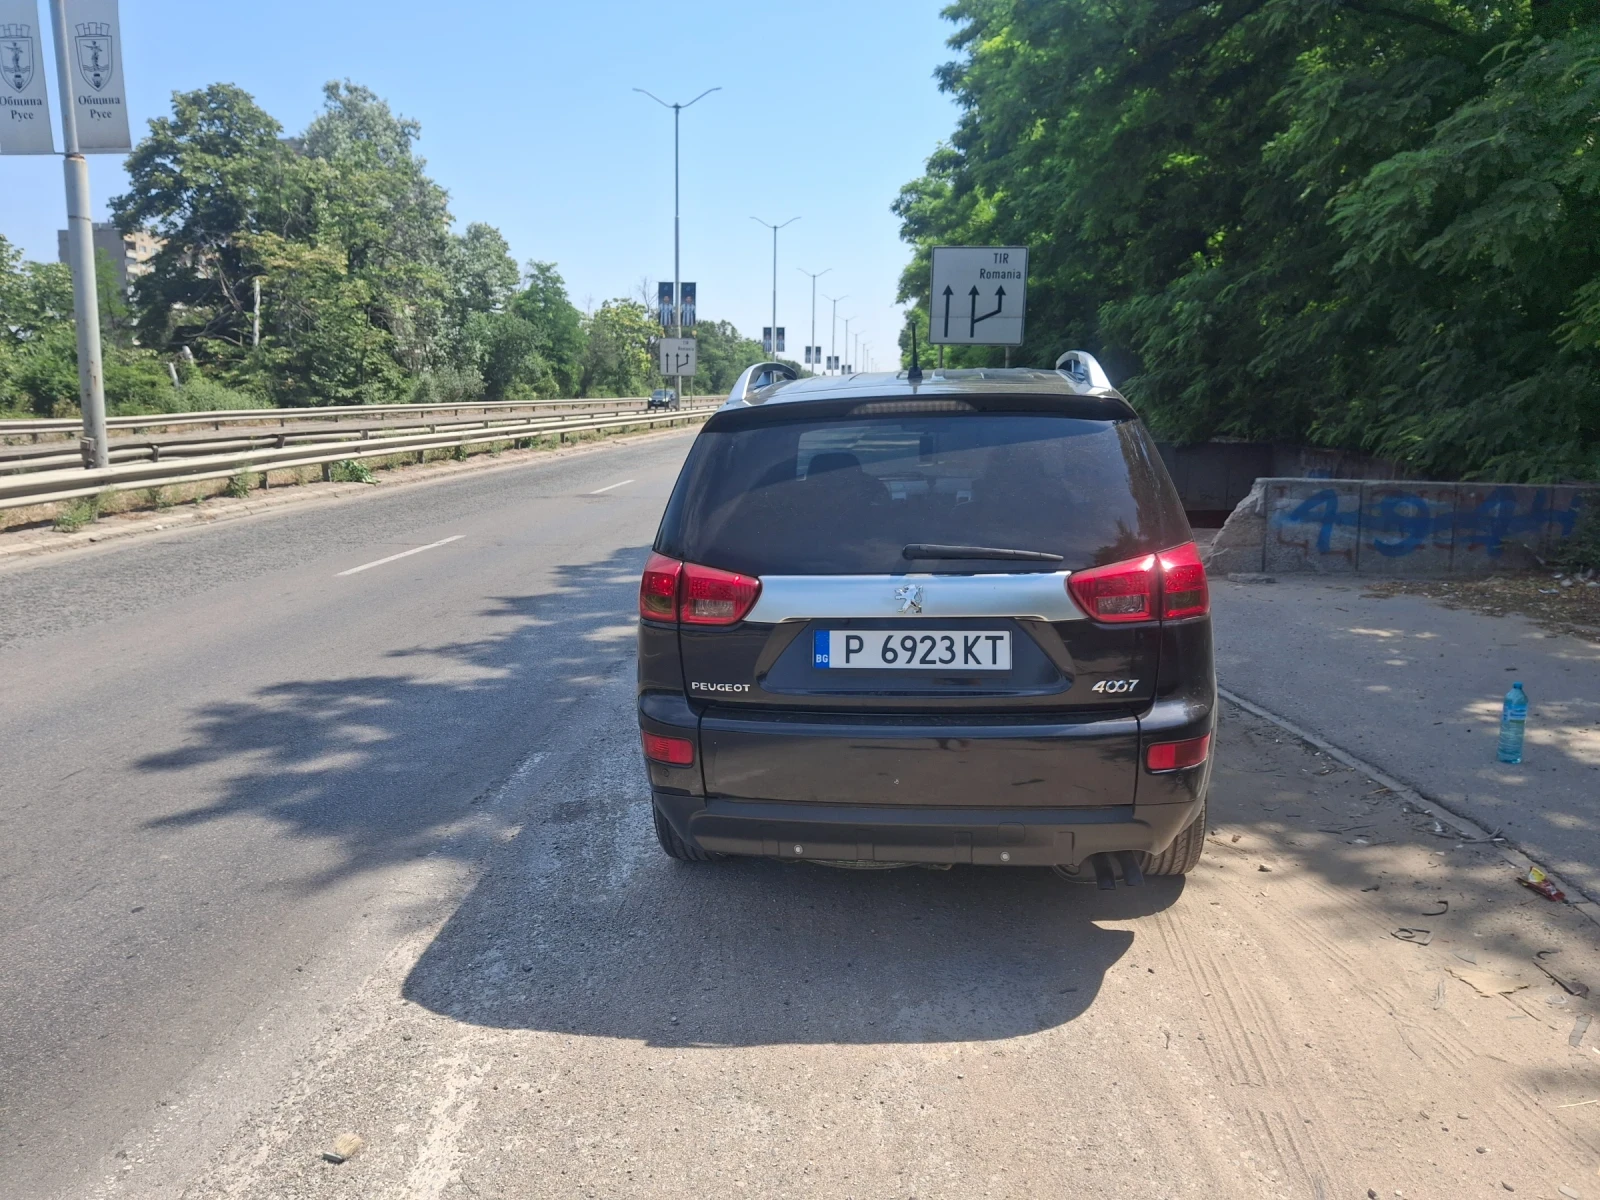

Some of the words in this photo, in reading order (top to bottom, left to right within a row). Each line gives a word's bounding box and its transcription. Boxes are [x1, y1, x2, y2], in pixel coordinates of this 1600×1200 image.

[0, 96, 42, 107] Община
[78, 95, 121, 106] Община
[11, 109, 34, 122] Русе
[90, 108, 112, 121] Русе
[994, 253, 1009, 264] TIR
[979, 268, 1022, 279] Romania
[845, 635, 864, 664] P
[881, 635, 1004, 665] 6923KT
[816, 654, 829, 663] BG
[691, 681, 750, 692] PEUGEOT
[1091, 679, 1139, 693] 4007
